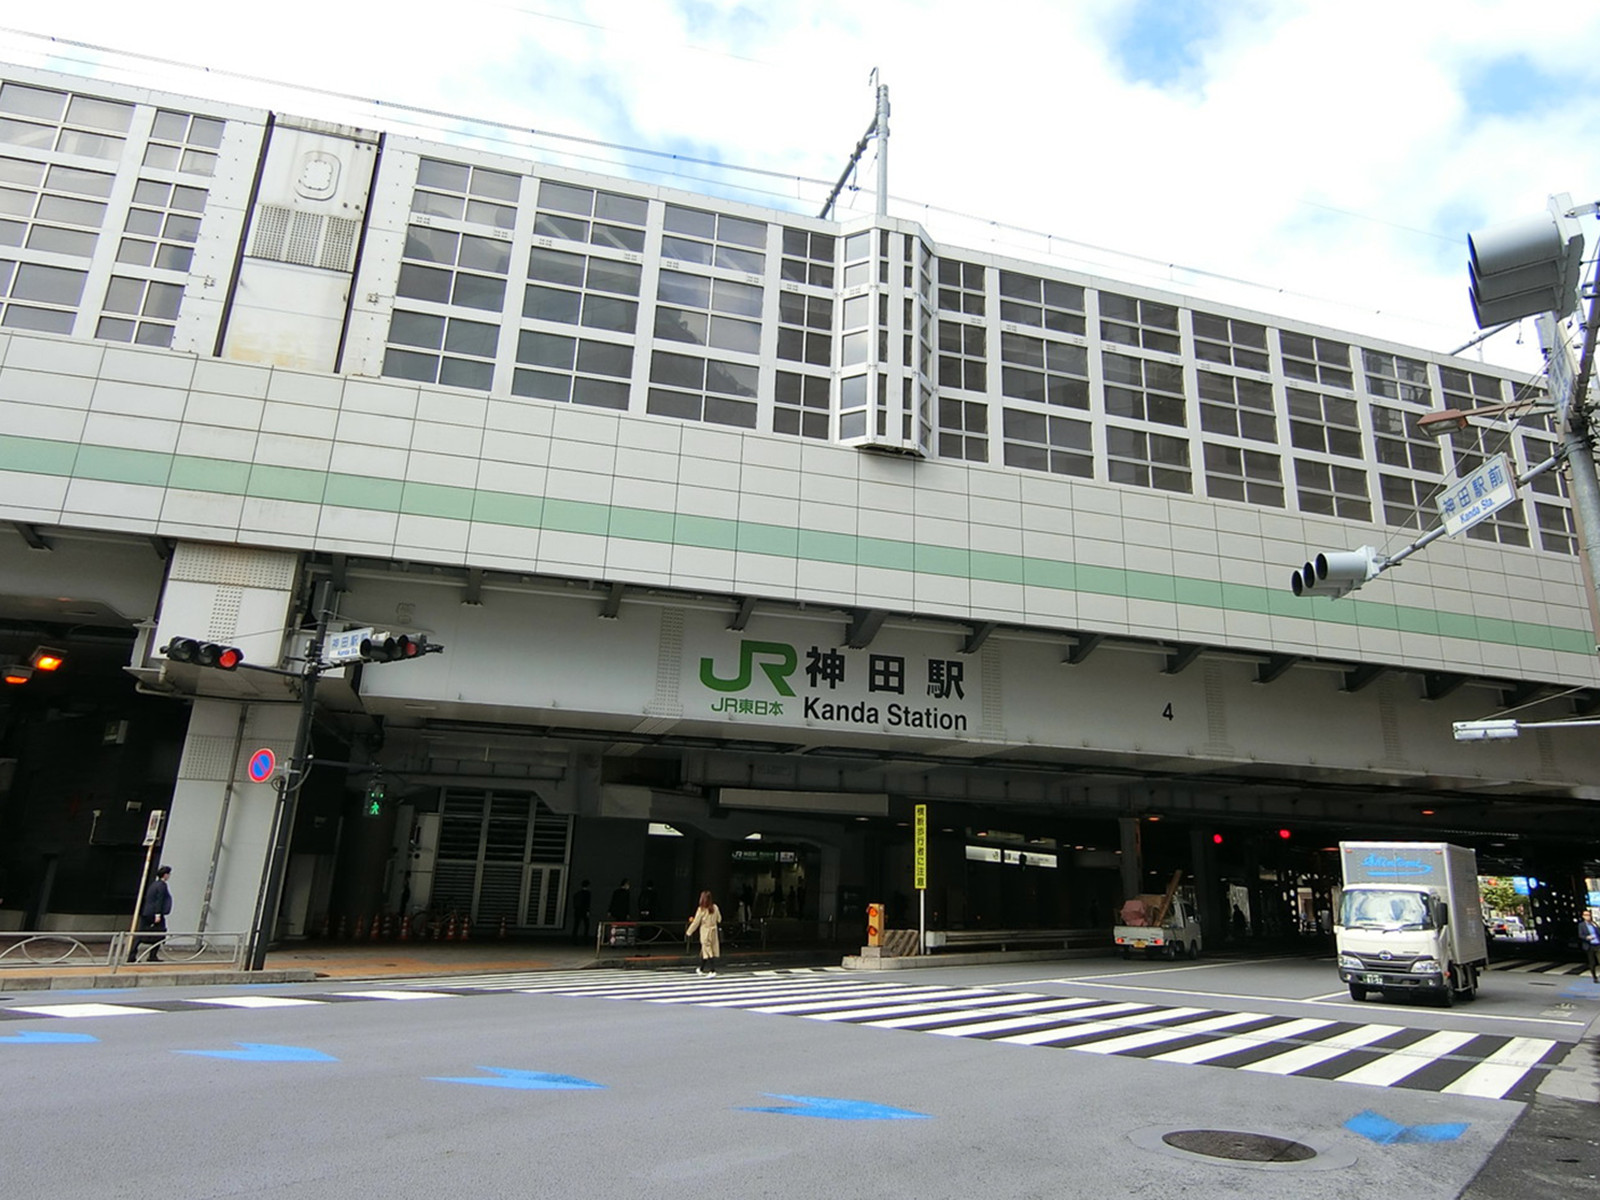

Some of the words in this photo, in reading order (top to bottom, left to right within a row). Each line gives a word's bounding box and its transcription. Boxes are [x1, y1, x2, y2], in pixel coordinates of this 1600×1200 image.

[1443, 465, 1504, 517] 神田駅前
[1460, 506, 1480, 523] Kanda
[1481, 498, 1495, 511] Sta.
[699, 639, 798, 697] JR
[805, 645, 965, 700] 神田駅
[711, 697, 784, 717] JR東日本
[803, 696, 880, 725] Kanda
[886, 702, 968, 731] Station
[1162, 702, 1174, 721] 4
